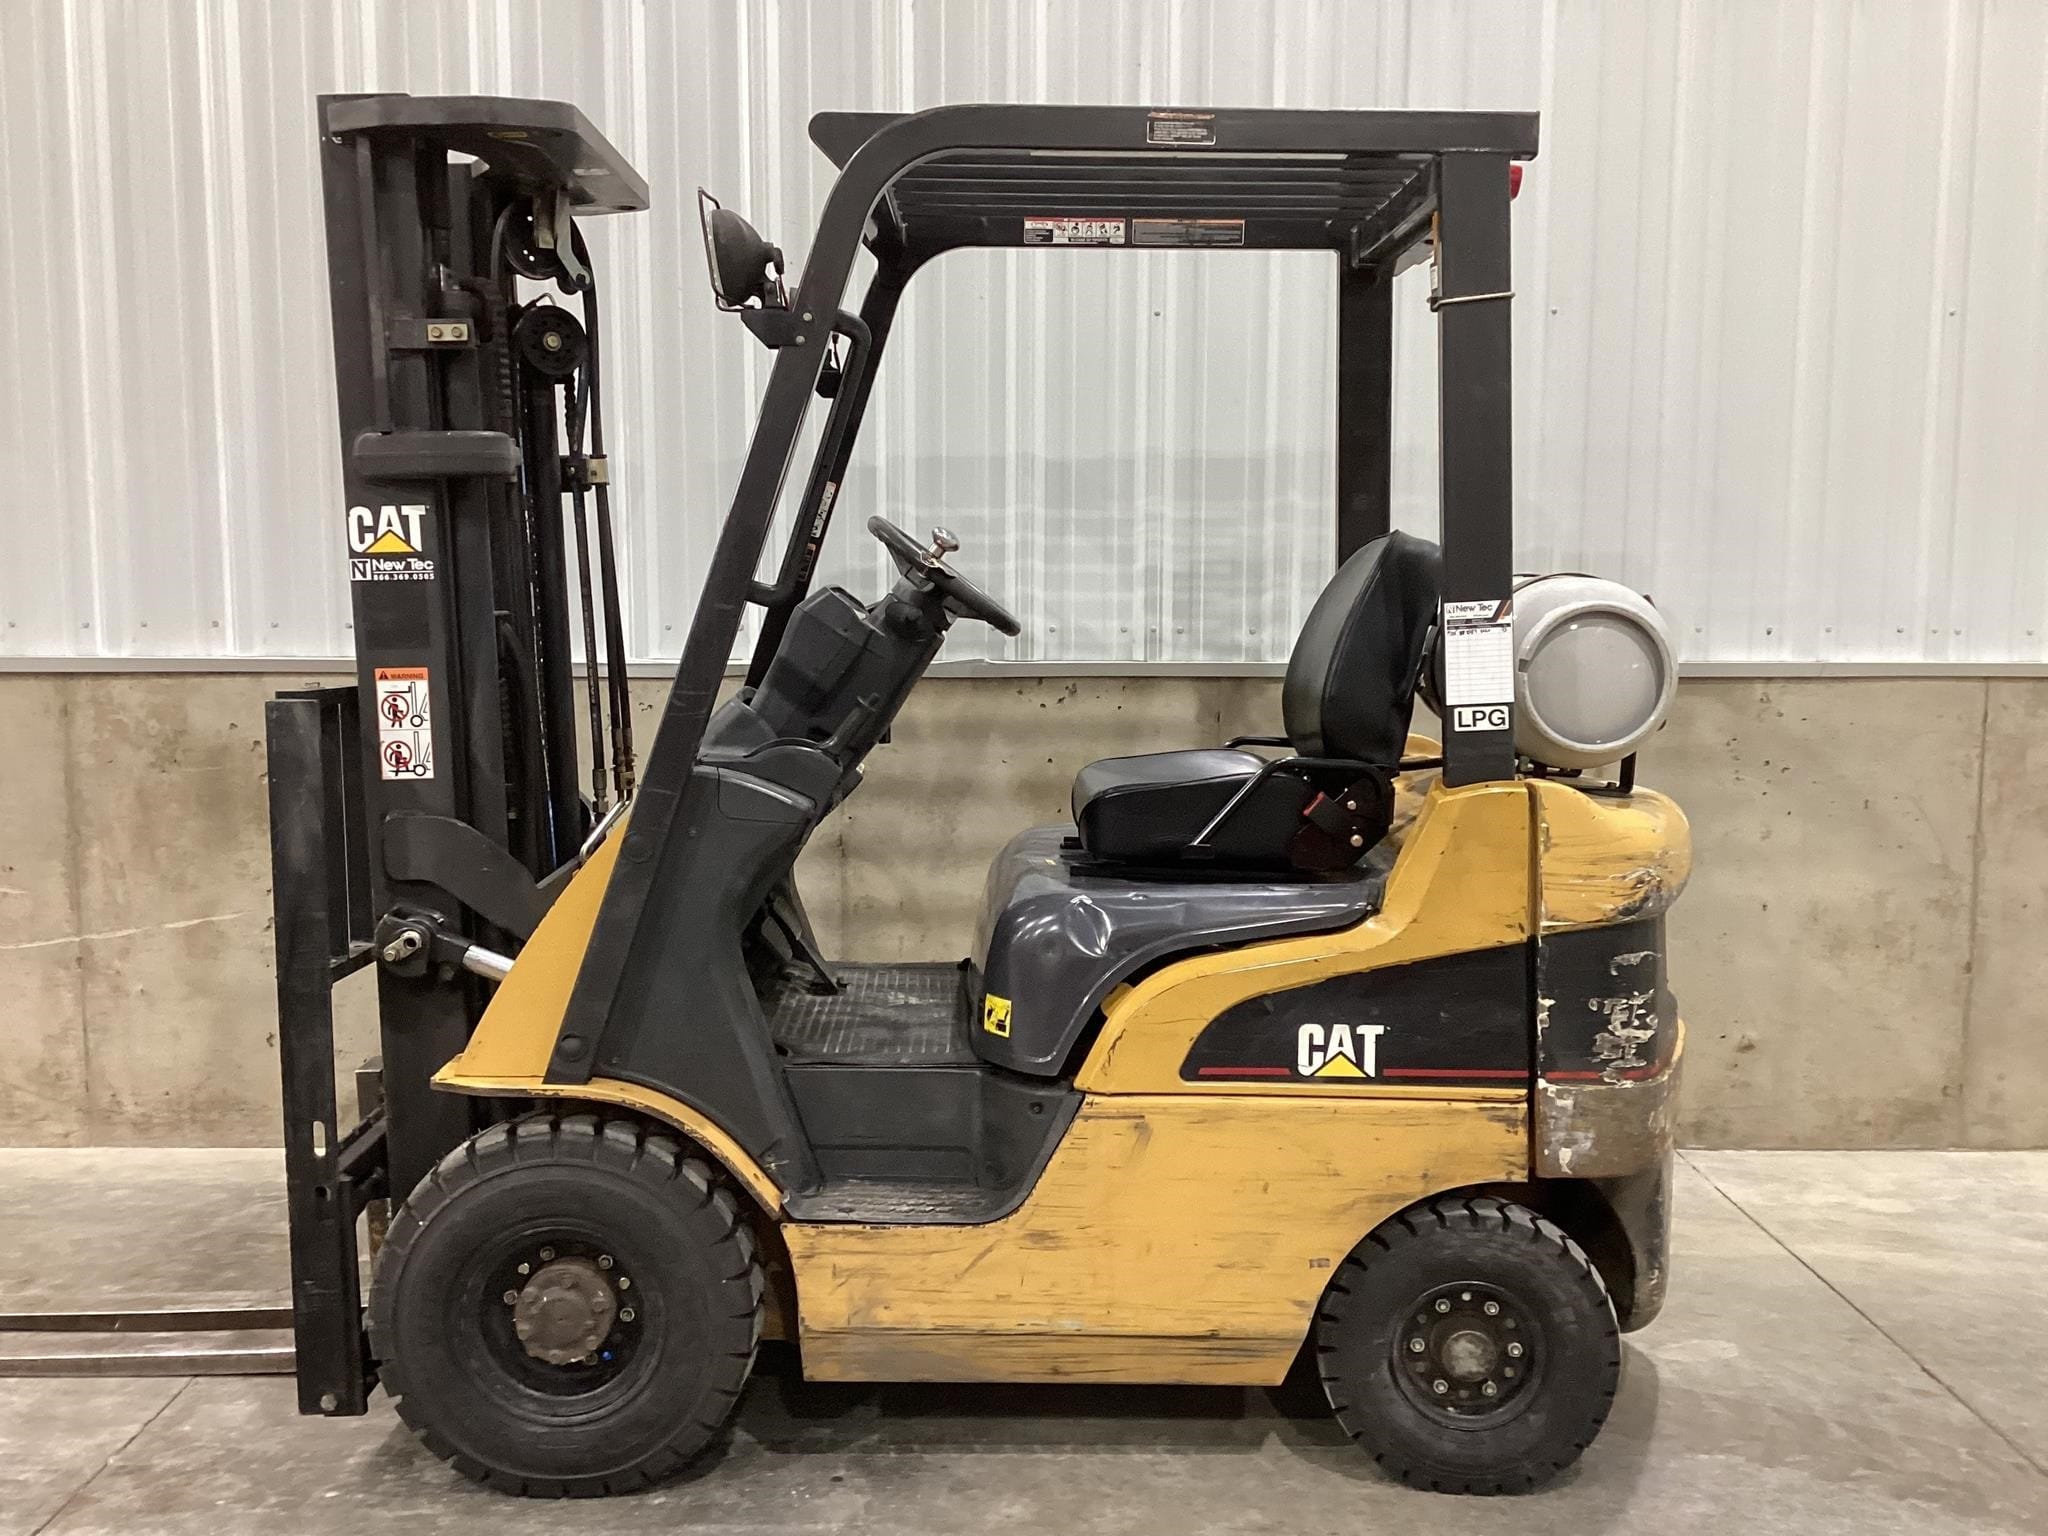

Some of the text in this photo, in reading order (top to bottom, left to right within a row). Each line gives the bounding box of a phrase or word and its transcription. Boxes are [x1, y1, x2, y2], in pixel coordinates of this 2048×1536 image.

[348, 505, 426, 553] CAT
[372, 559, 405, 571] New
[406, 558, 434, 570] Tec
[1458, 709, 1506, 728] LPG
[1297, 1023, 1385, 1078] CAT
